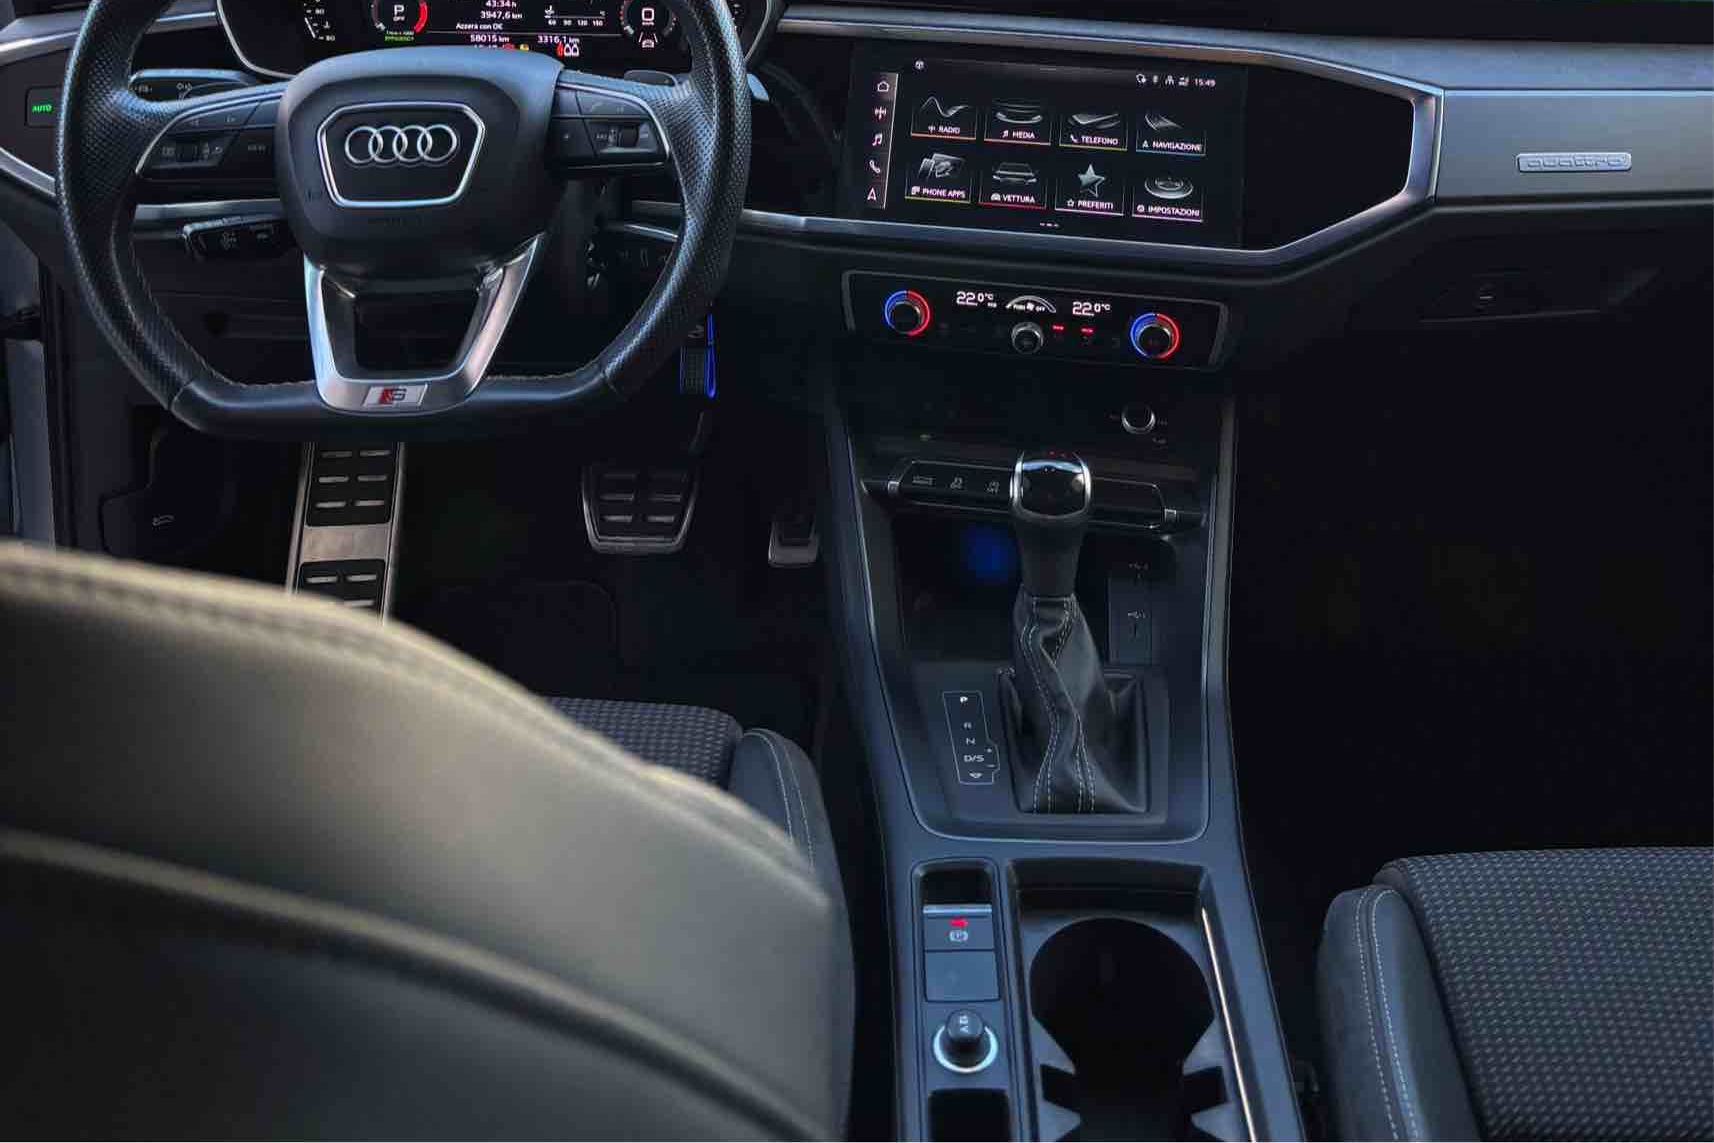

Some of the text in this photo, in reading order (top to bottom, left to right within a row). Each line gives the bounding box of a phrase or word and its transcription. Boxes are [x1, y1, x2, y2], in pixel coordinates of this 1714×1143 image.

[485, 0, 511, 8] 43:34
[393, 3, 405, 16] P
[480, 10, 511, 20] 3947,6
[498, 35, 511, 43] km
[31, 104, 53, 114] AUTO
[938, 125, 961, 135] RADIO
[1012, 131, 1036, 140] MEDIA
[1080, 136, 1119, 146] TELEFONO
[1151, 141, 1202, 152] NAVIGAZIONE
[921, 188, 967, 200] PHONE APPS
[1002, 193, 1036, 203] VETTURA
[1077, 200, 1114, 209] PREFERITI
[1147, 205, 1201, 217] IMPOSTAZIONI
[963, 754, 984, 762] D/S
